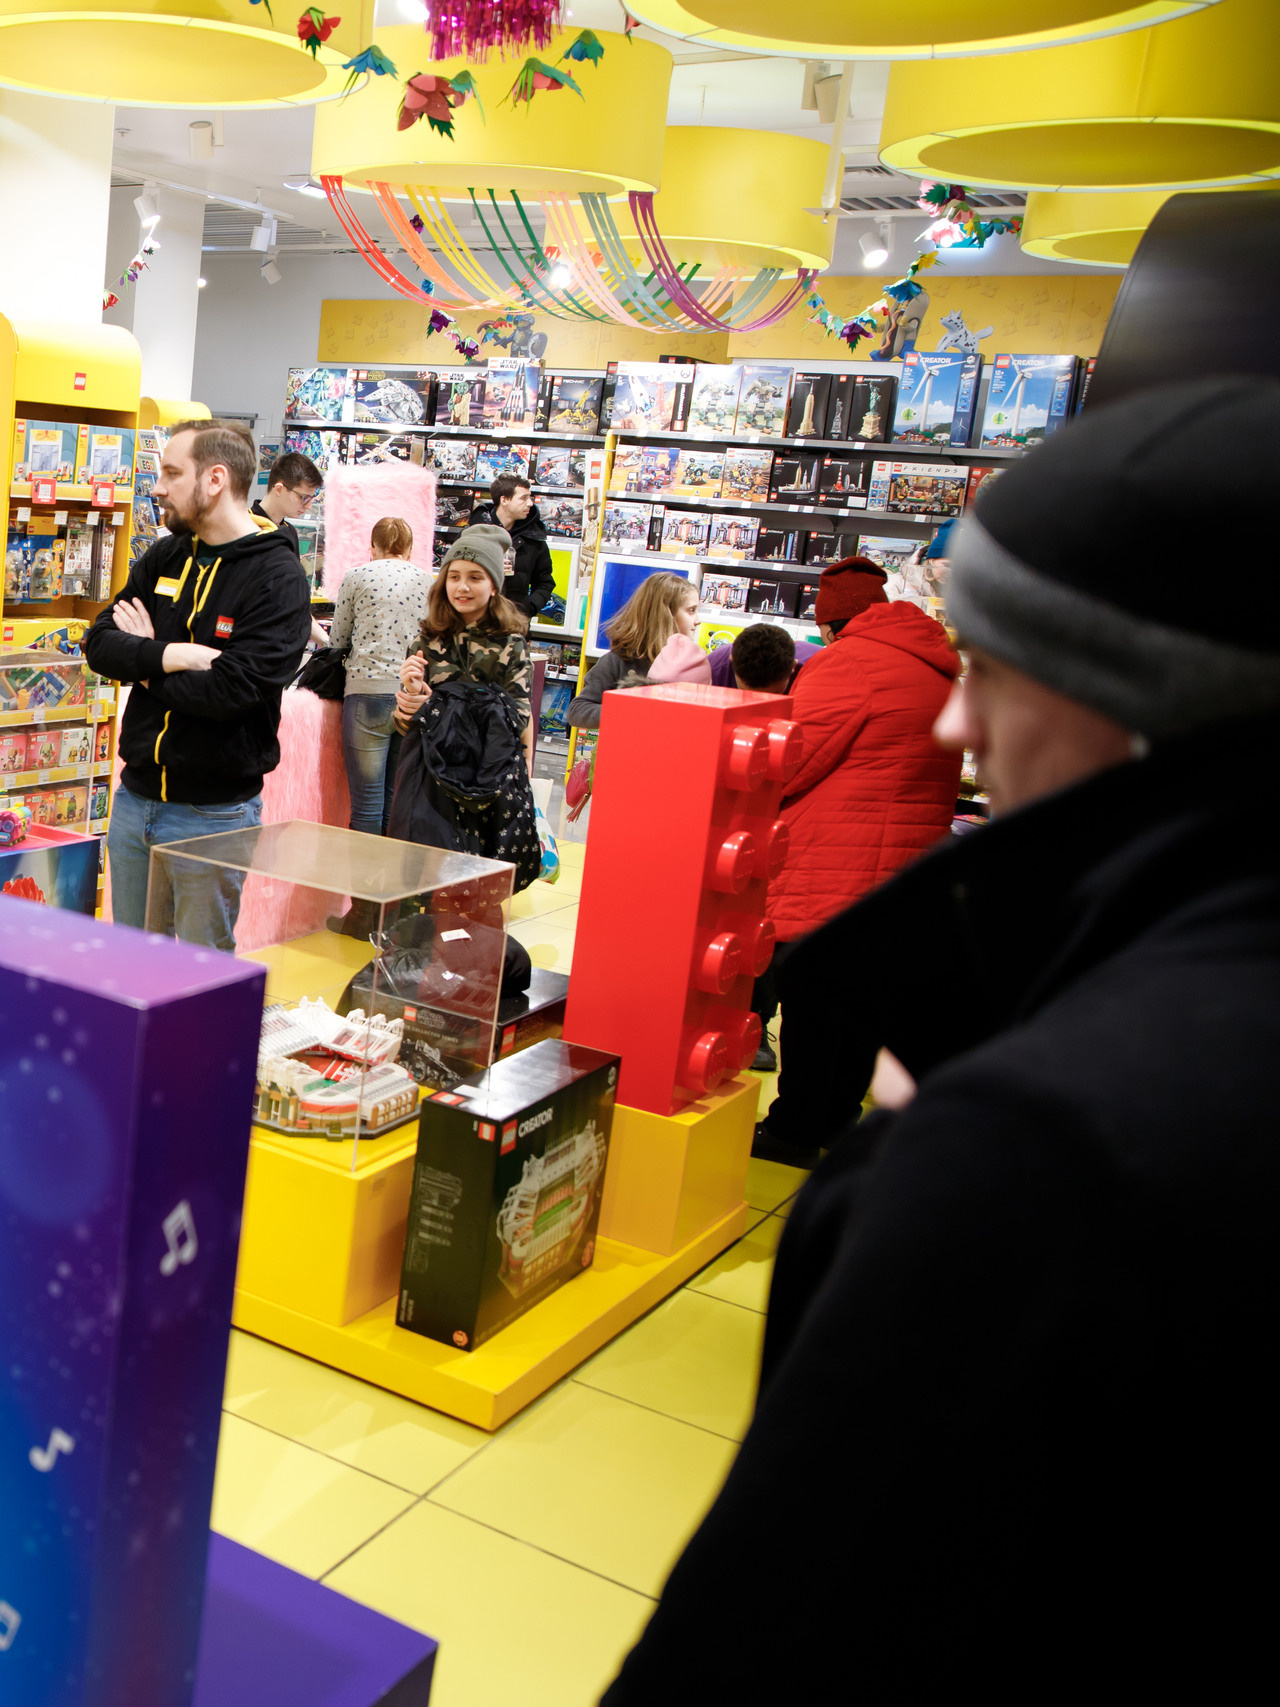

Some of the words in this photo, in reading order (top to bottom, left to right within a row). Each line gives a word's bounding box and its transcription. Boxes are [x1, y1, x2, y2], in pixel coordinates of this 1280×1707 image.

[920, 356, 952, 364] CREATOR
[502, 1128, 516, 1147] LEGO
[518, 1107, 553, 1138] CREATOR
